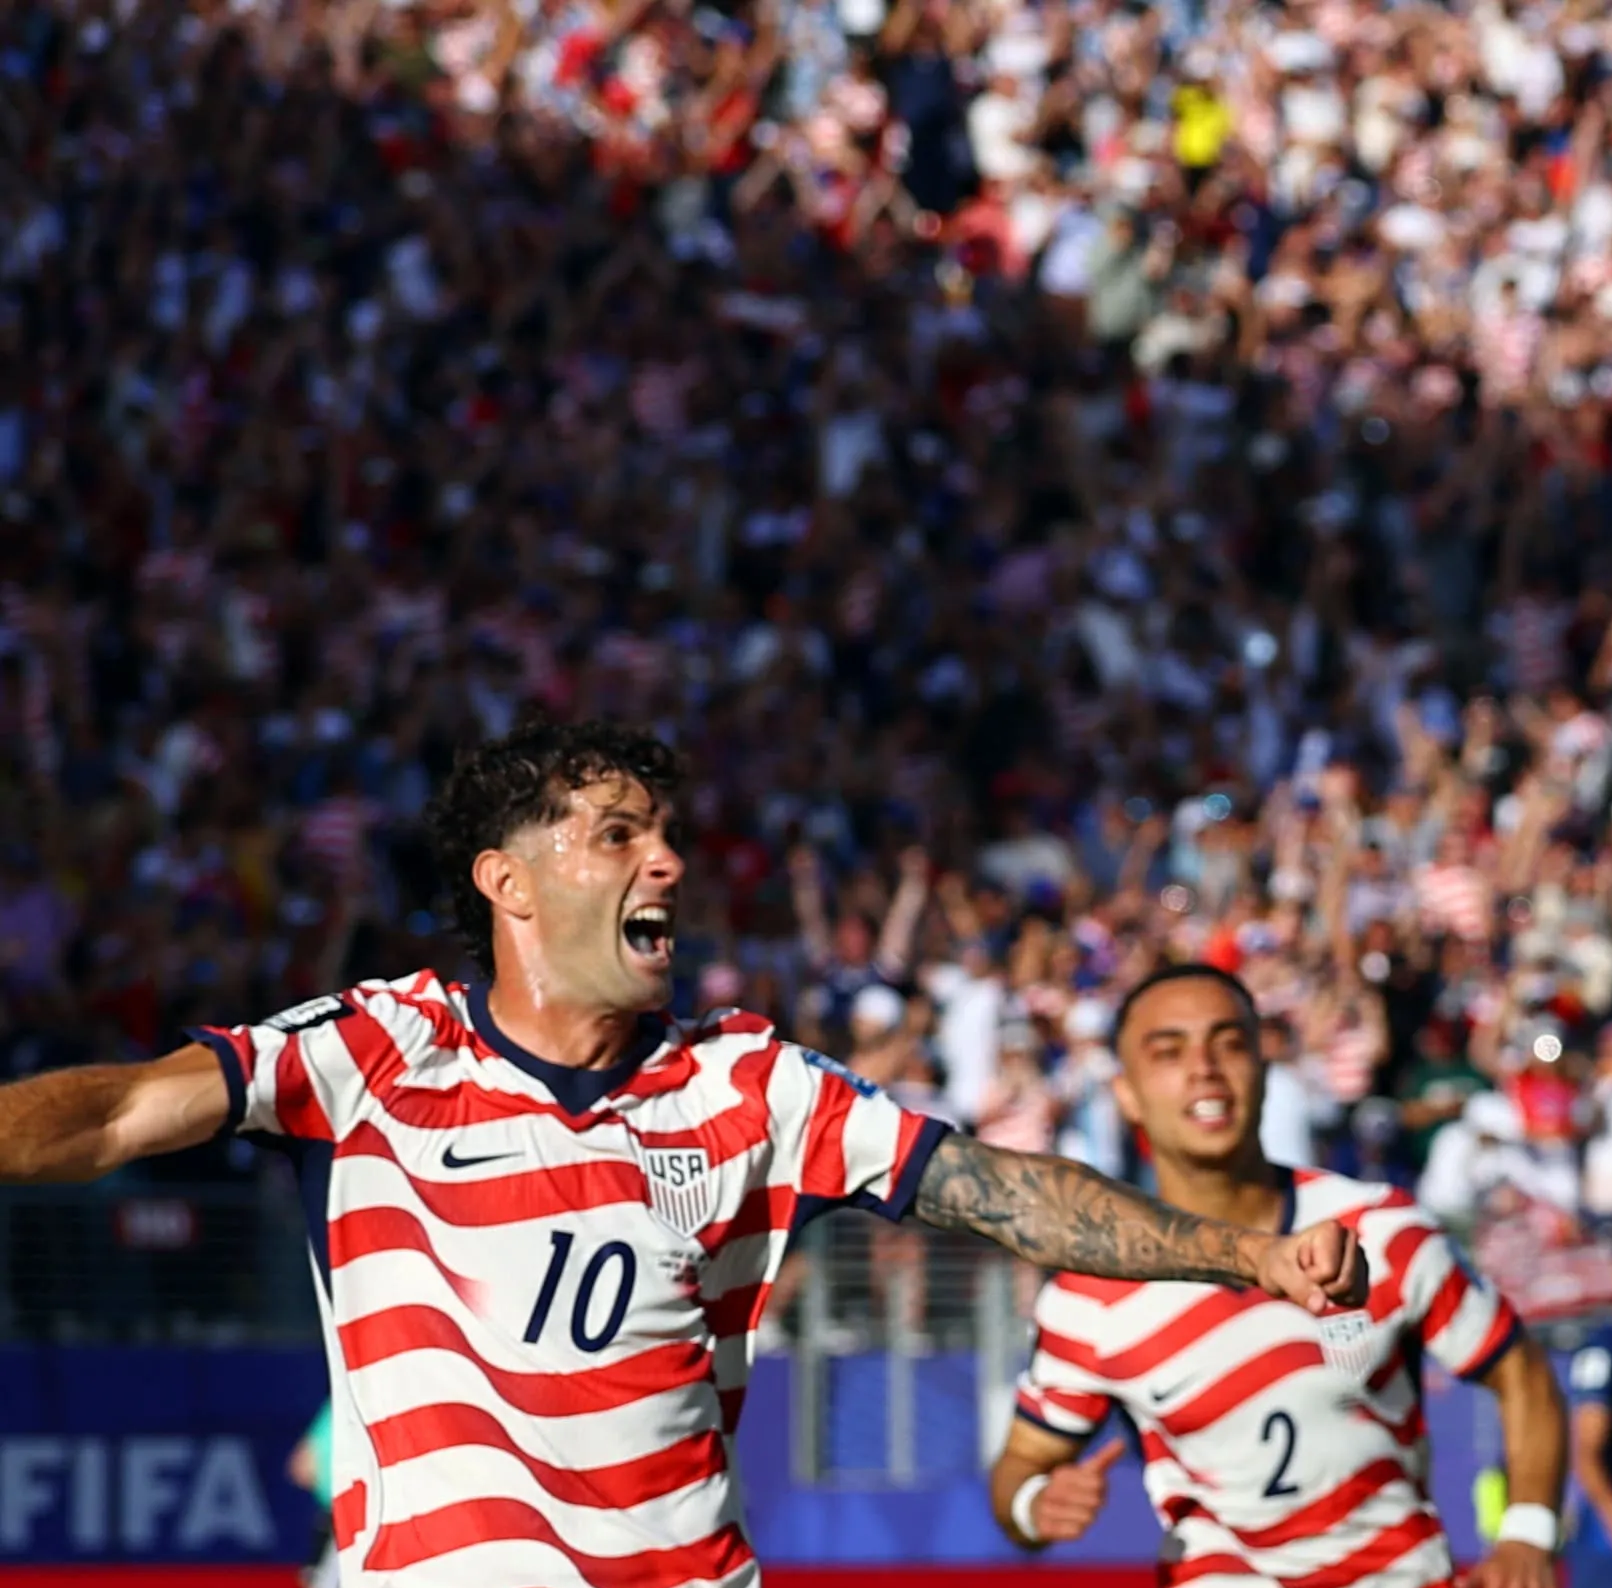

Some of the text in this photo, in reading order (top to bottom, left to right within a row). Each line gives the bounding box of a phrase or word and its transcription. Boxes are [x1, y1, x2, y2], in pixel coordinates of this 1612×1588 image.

[650, 1154, 704, 1187] USA
[524, 1230, 637, 1352] 10
[0, 1434, 277, 1550] FIFA
[1262, 1411, 1300, 1498] 2
